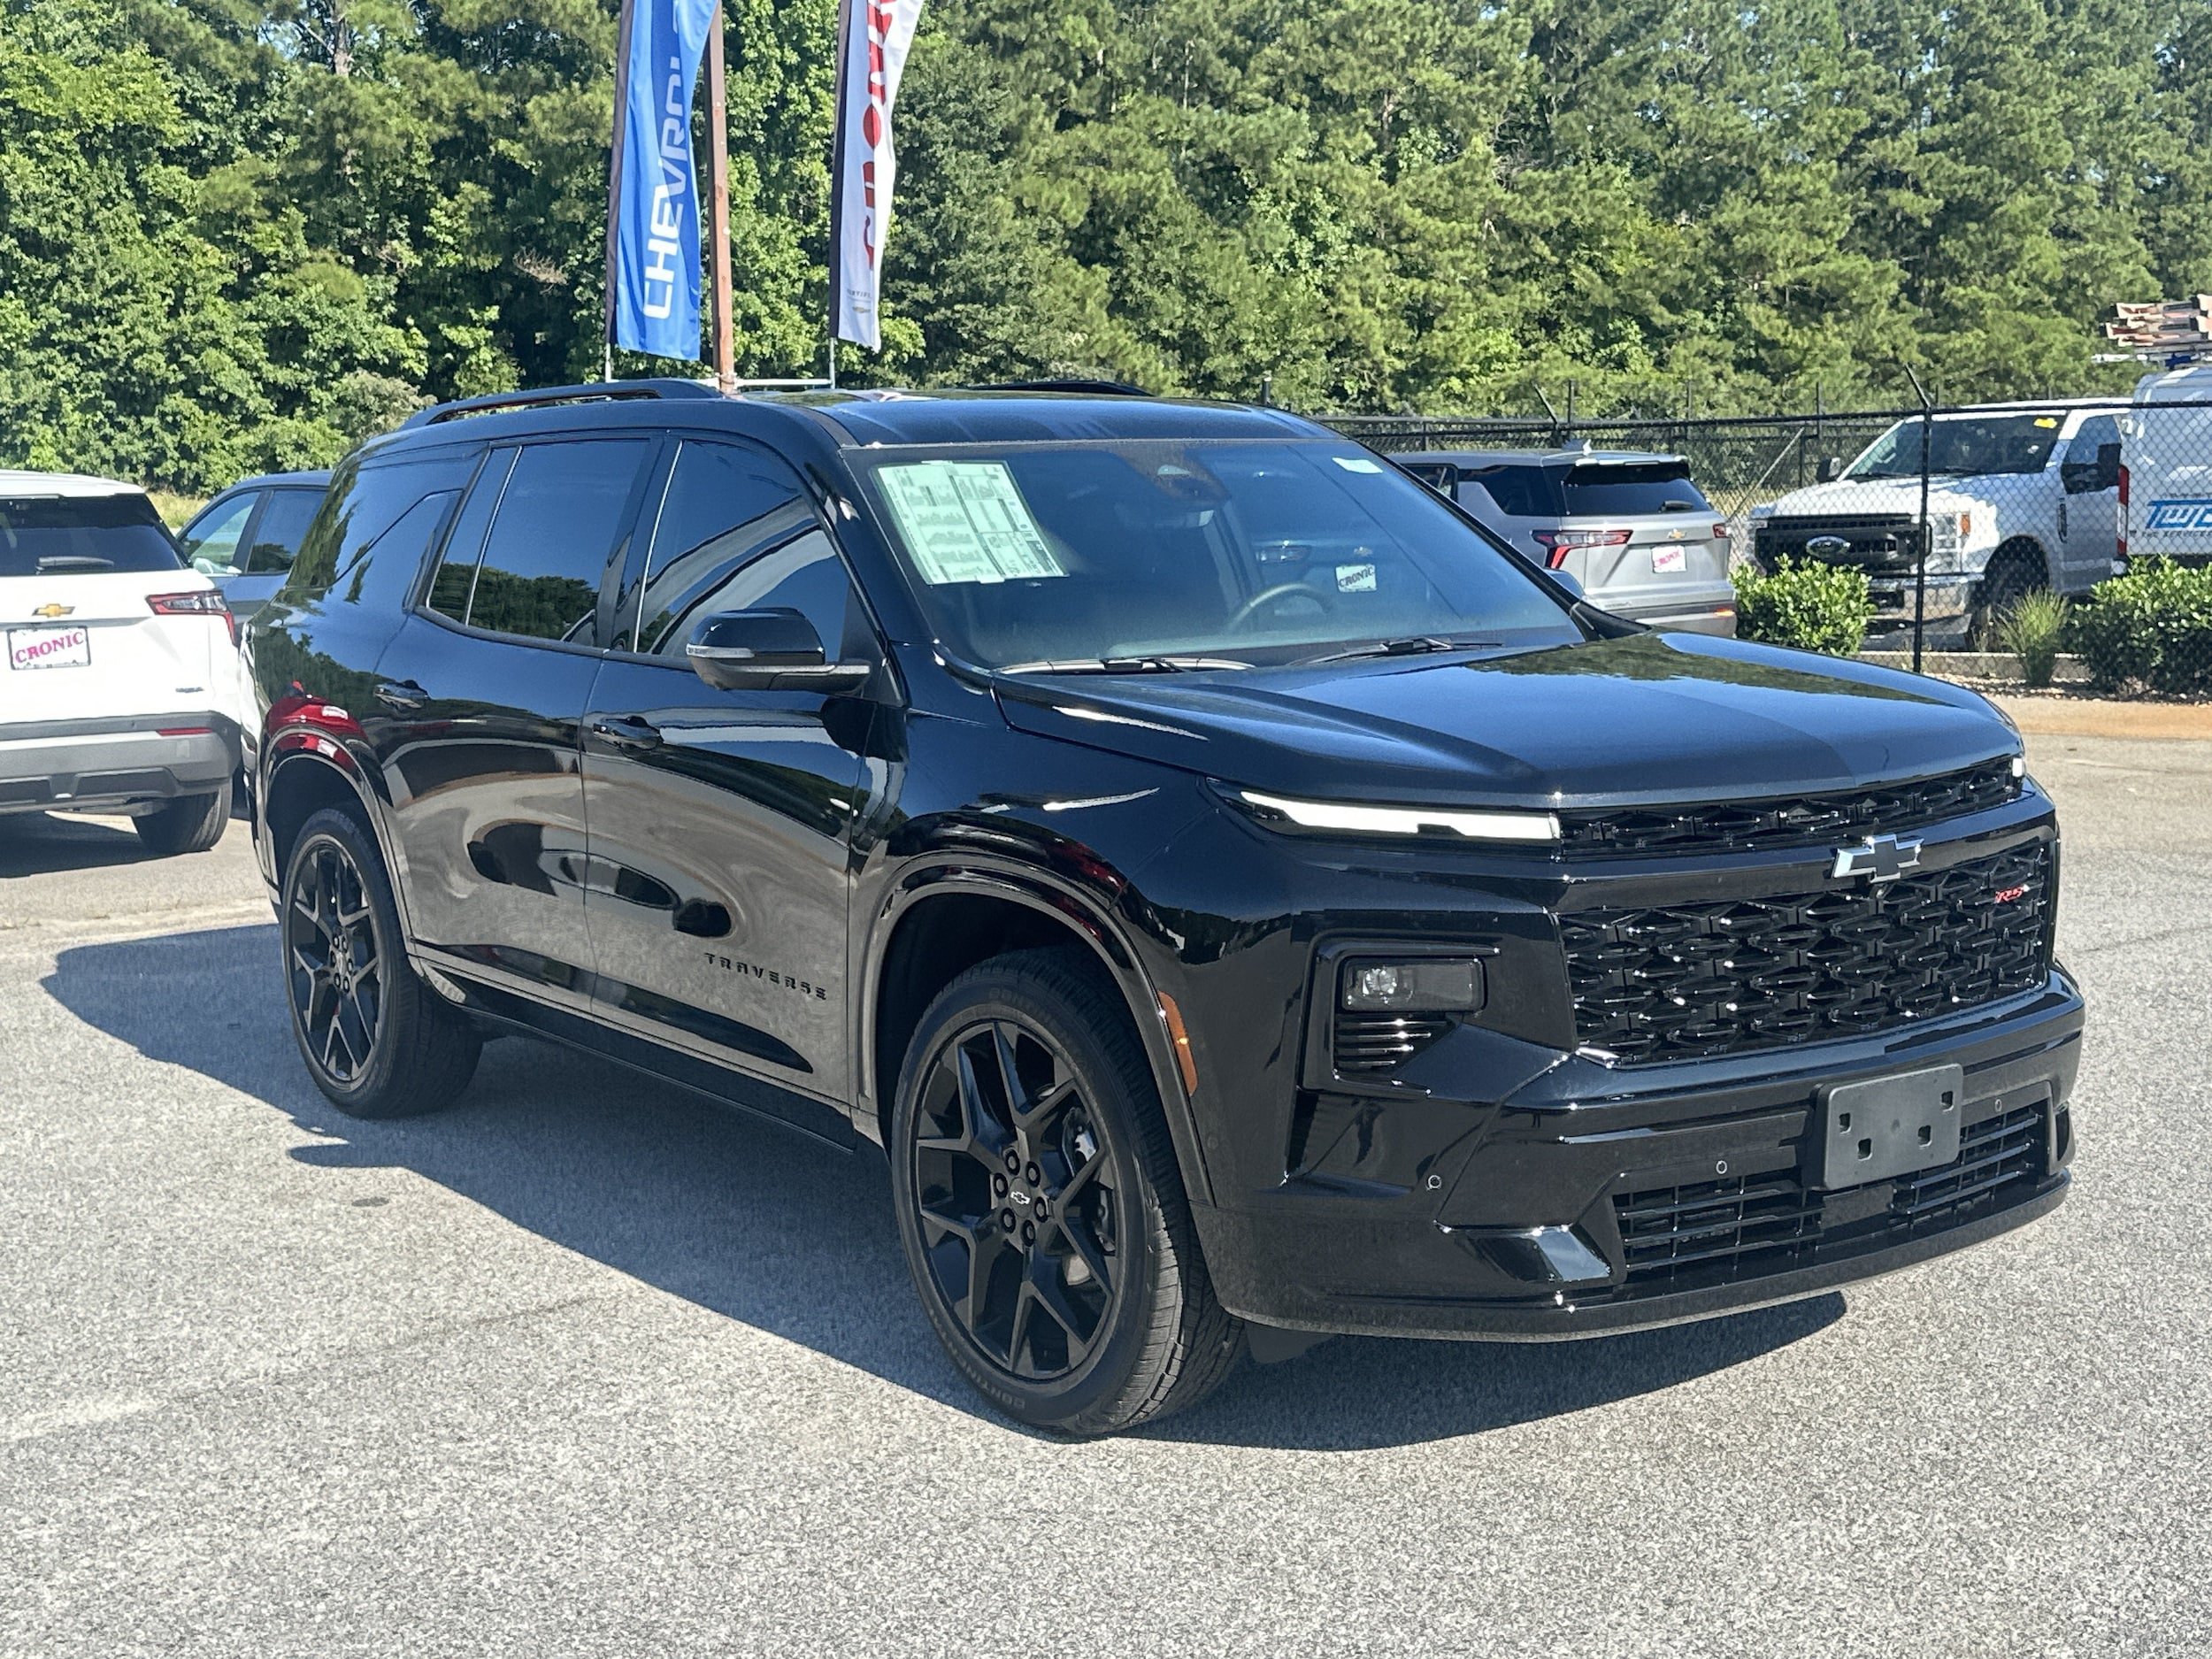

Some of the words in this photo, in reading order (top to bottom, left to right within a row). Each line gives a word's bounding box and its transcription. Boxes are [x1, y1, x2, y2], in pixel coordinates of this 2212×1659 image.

[1339, 566, 1374, 588] CRONIC
[15, 632, 84, 664] CRONIC
[704, 952, 826, 1001] TRAVERSE
